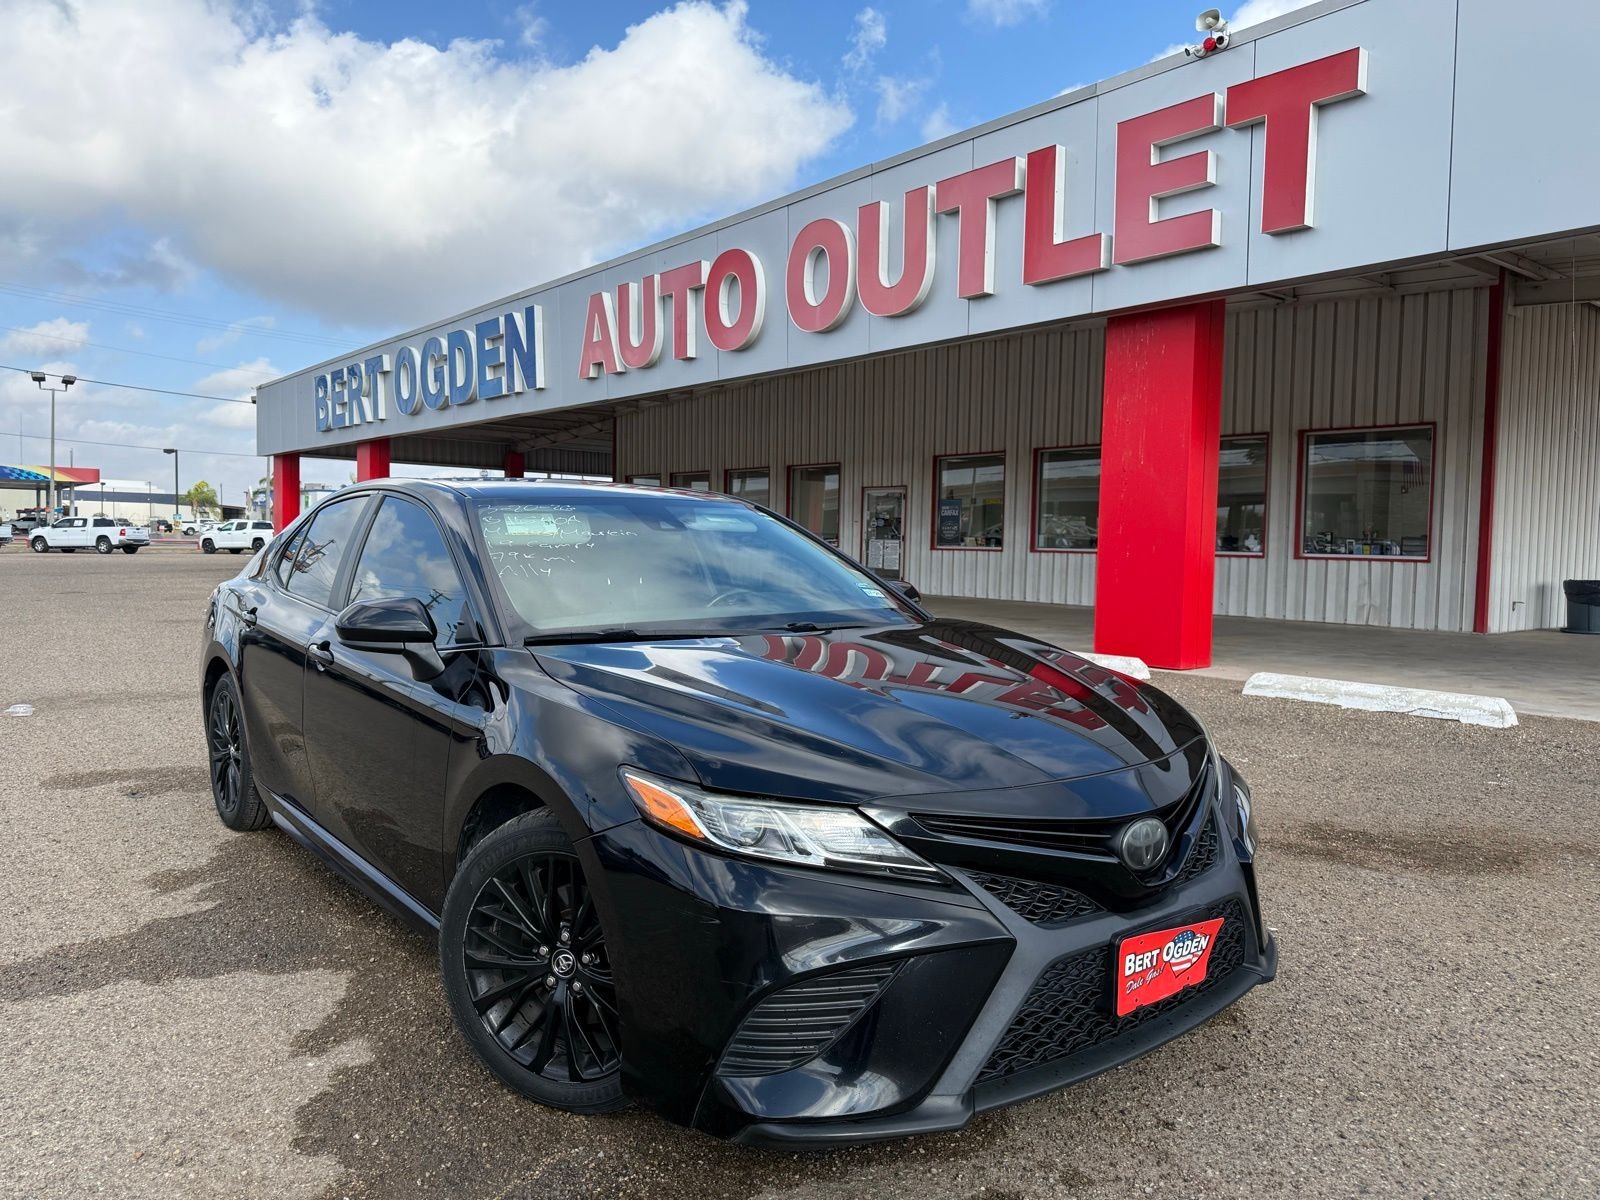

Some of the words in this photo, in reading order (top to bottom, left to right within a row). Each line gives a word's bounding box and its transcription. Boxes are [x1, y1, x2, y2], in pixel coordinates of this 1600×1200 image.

[315, 354, 390, 432] BERT
[394, 304, 545, 416] OGDEN
[578, 246, 766, 380] AUTO
[785, 46, 1368, 334] OUTLET
[1124, 949, 1161, 977] BERT
[1162, 935, 1210, 962] OGDEN
